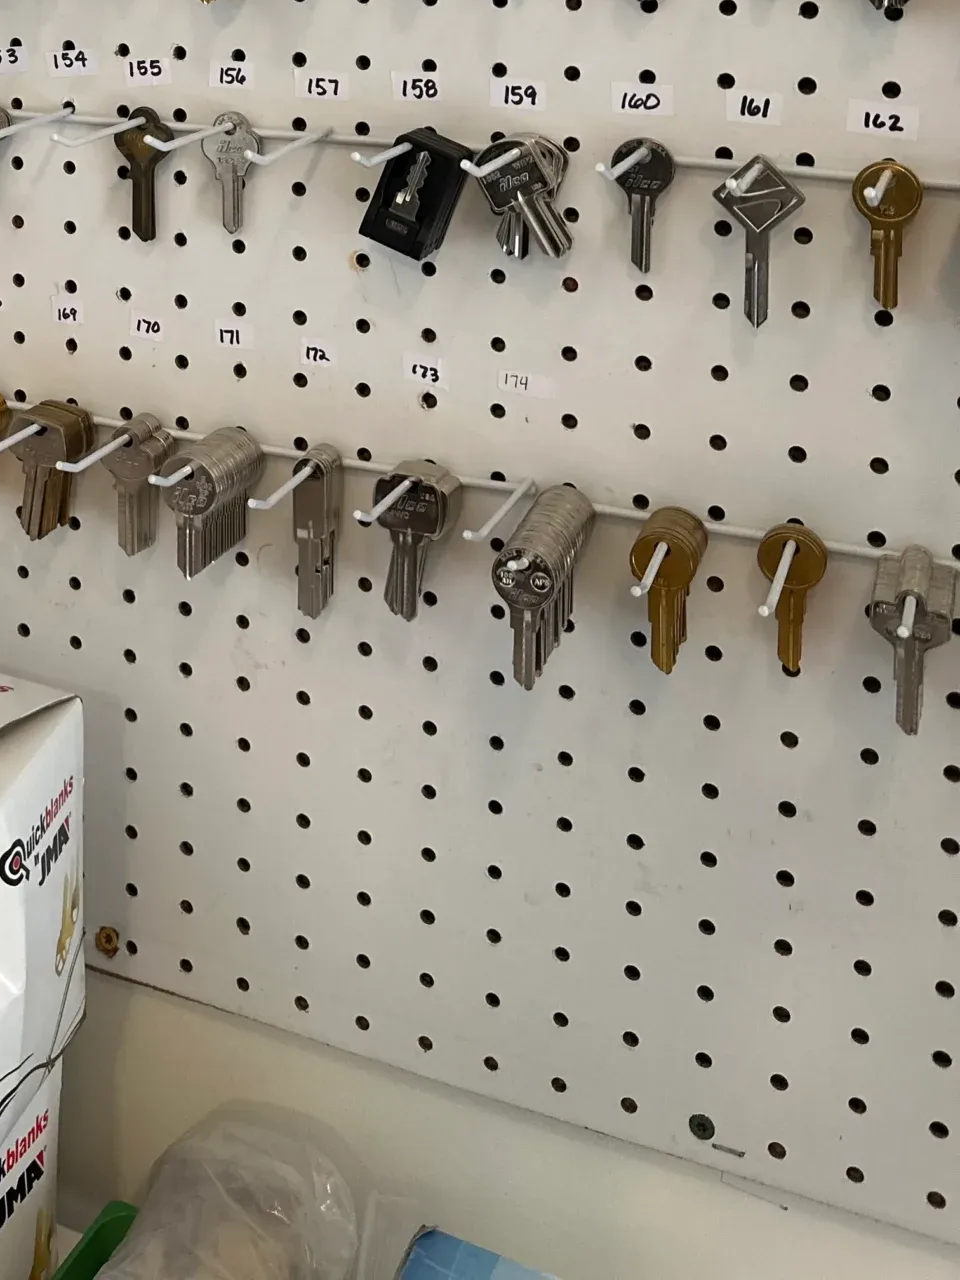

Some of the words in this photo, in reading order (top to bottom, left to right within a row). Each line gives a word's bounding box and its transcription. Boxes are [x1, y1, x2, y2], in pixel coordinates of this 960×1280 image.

[53, 51, 88, 68] 154
[129, 60, 162, 77] 155
[219, 67, 246, 84] 156
[307, 78, 339, 96] 157
[402, 79, 438, 98] 158
[504, 85, 537, 105] 159
[621, 92, 661, 110] 160
[740, 95, 770, 118] 161
[864, 112, 904, 131] 162
[624, 175, 662, 190] ilco
[58, 308, 77, 321] 169
[136, 319, 160, 334] 170
[219, 329, 240, 345] 171
[306, 346, 330, 362] 172
[411, 363, 440, 382] 173
[504, 373, 529, 391] 174
[38, 816, 72, 887] JMA
